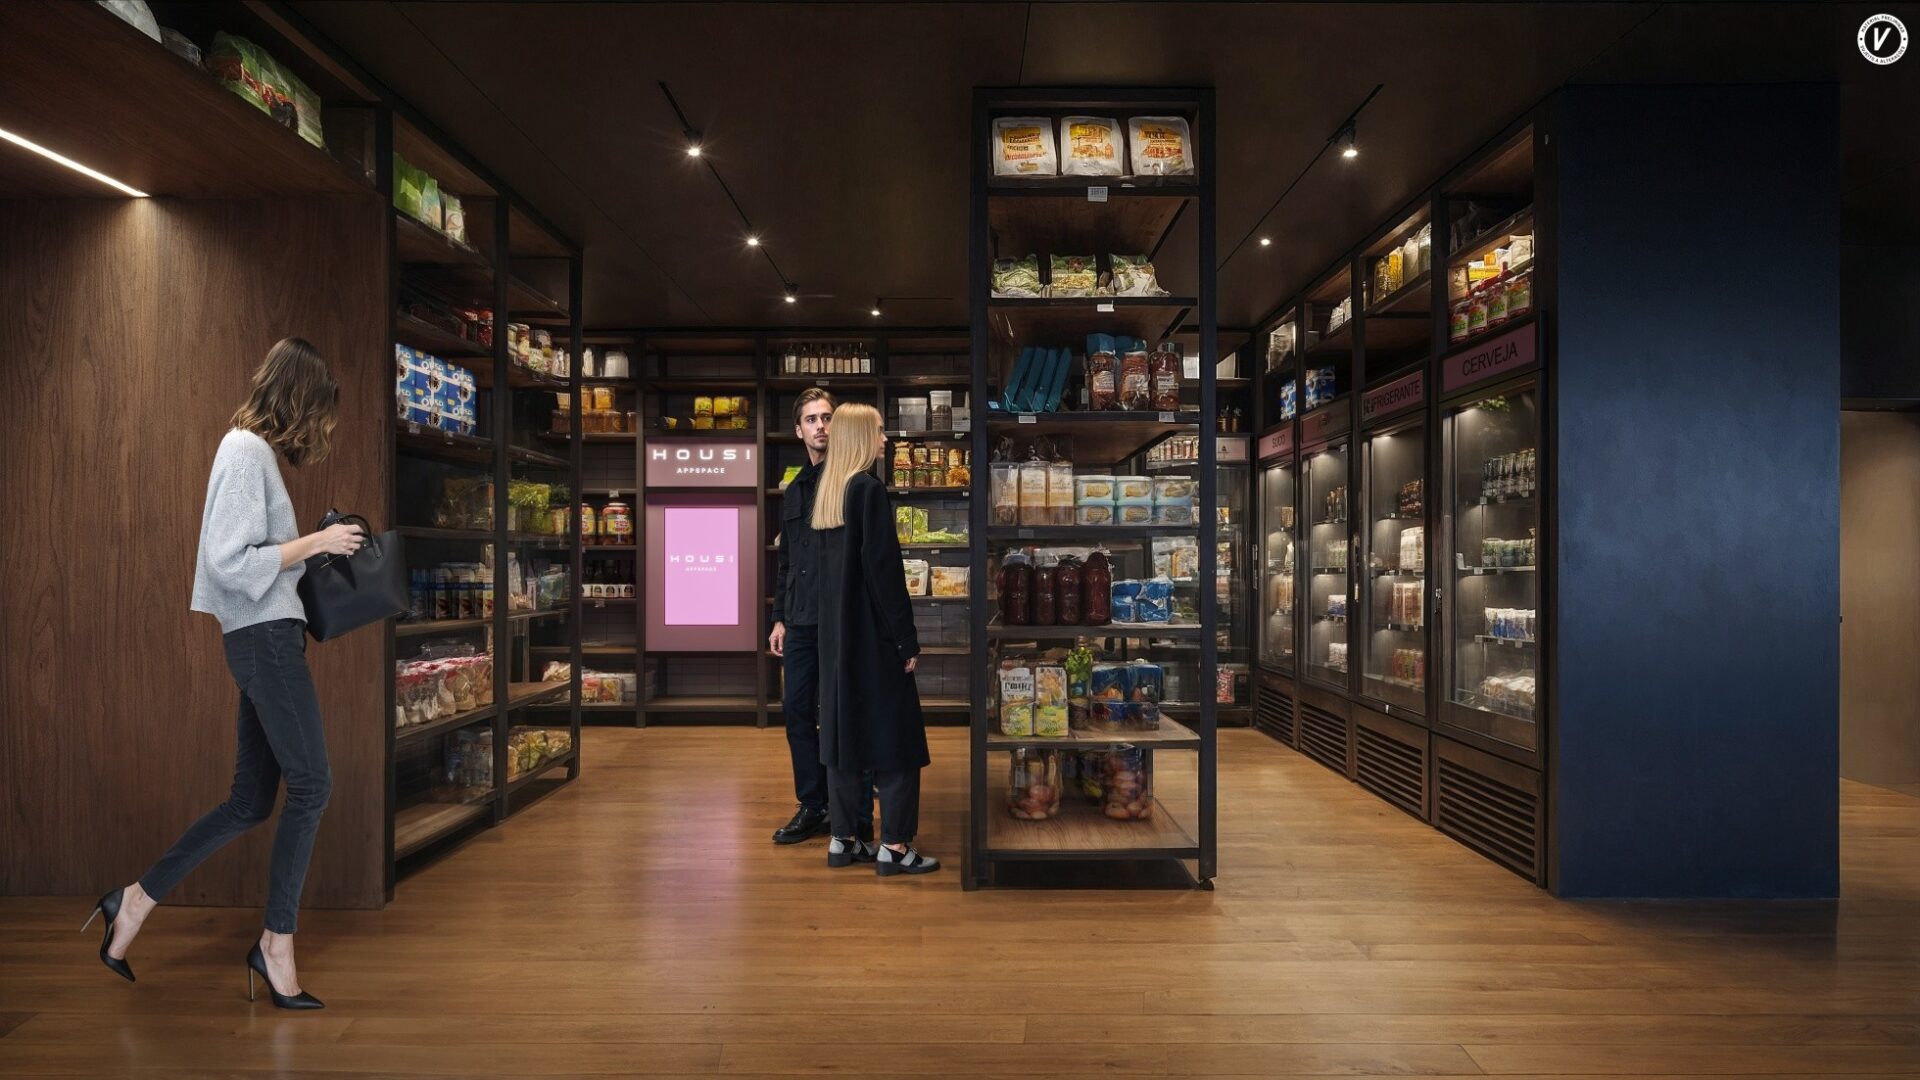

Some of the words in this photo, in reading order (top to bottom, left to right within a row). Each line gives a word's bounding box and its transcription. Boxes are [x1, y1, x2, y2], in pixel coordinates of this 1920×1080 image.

[1462, 341, 1518, 377] CERVEJA
[652, 448, 751, 460] HOUSI
[670, 555, 734, 563] HOUSI
